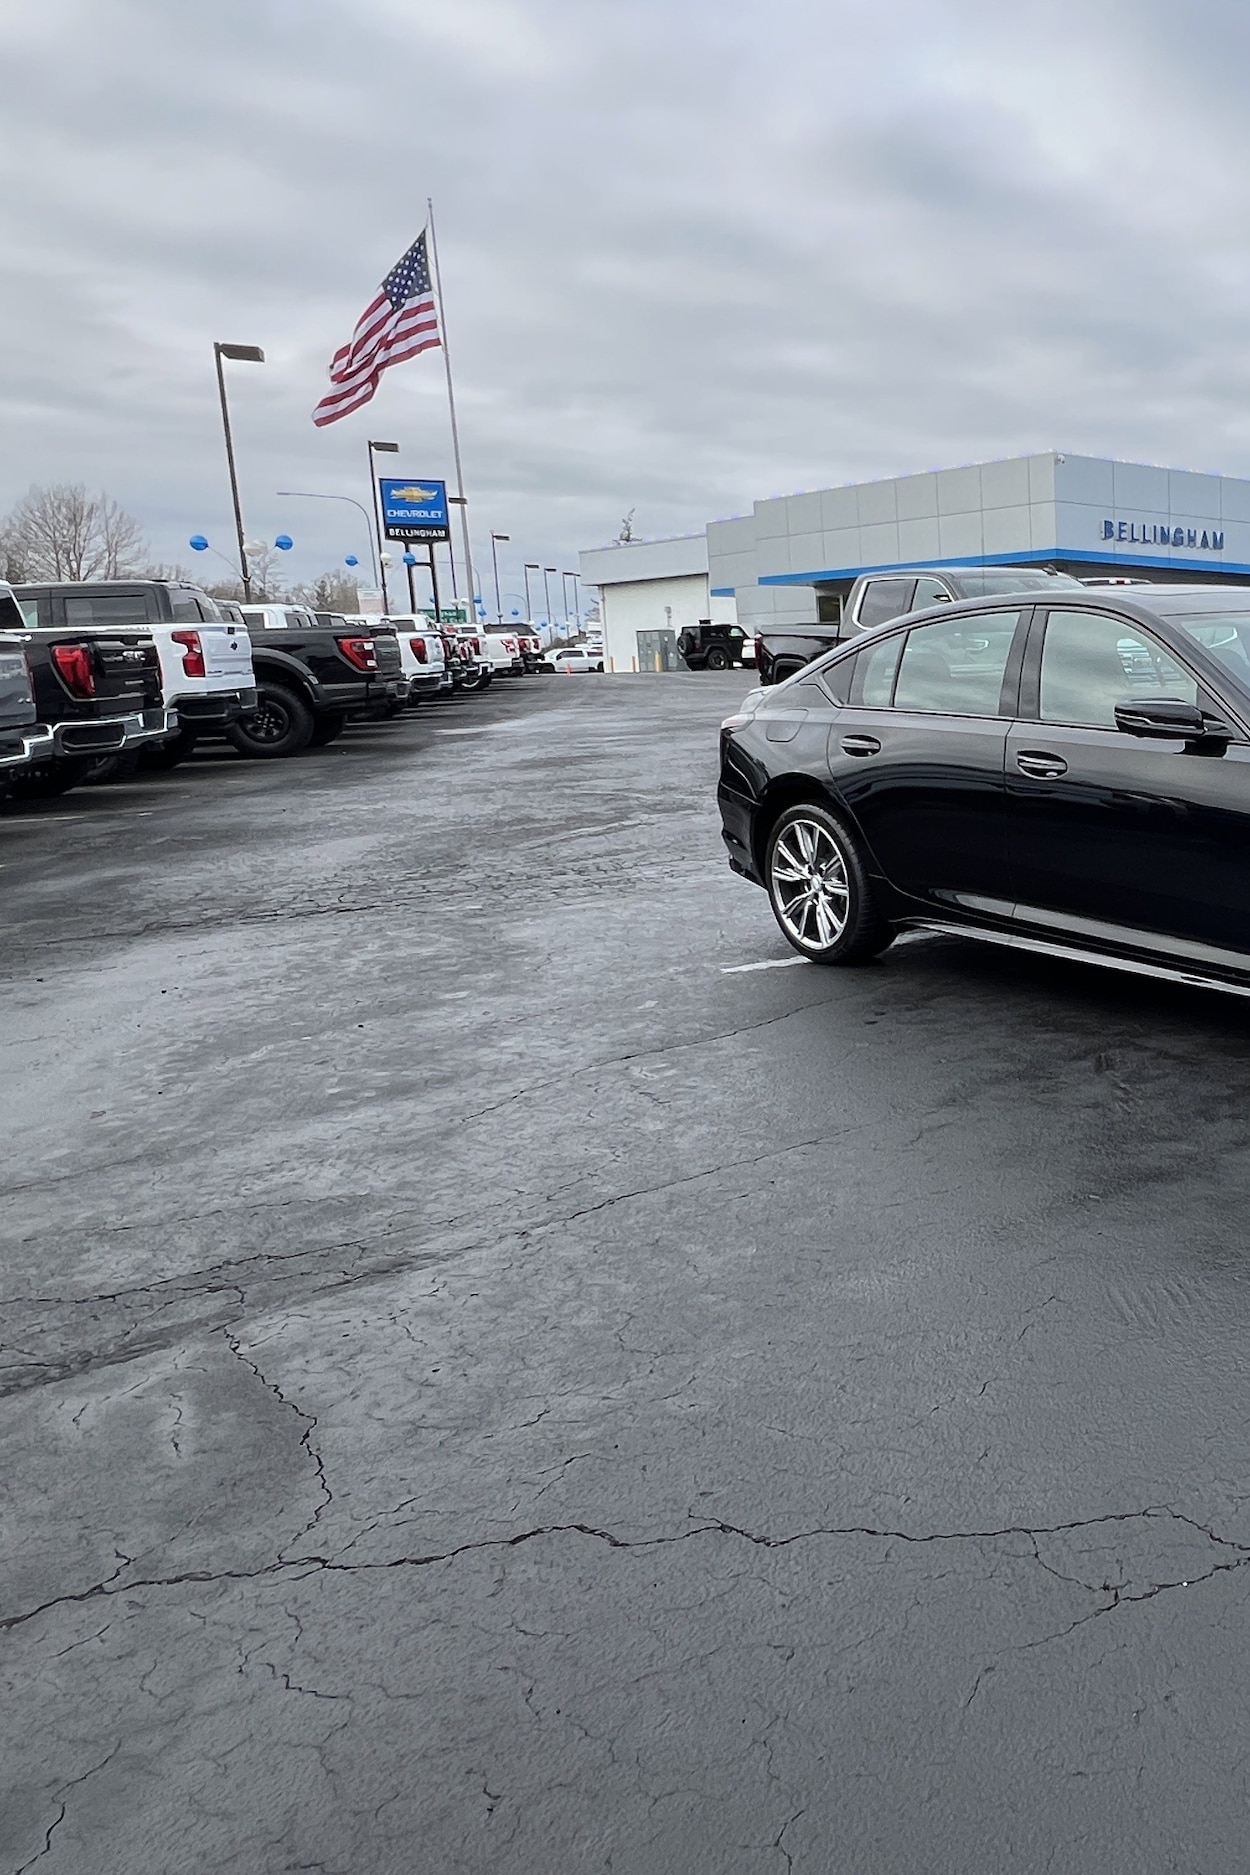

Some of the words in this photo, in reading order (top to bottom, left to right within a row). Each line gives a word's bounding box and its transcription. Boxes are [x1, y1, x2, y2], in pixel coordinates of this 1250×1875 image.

[387, 509, 443, 519] CHEVROLET
[388, 528, 446, 538] BELLINGHAM
[1101, 519, 1224, 550] BELLINGHAM
